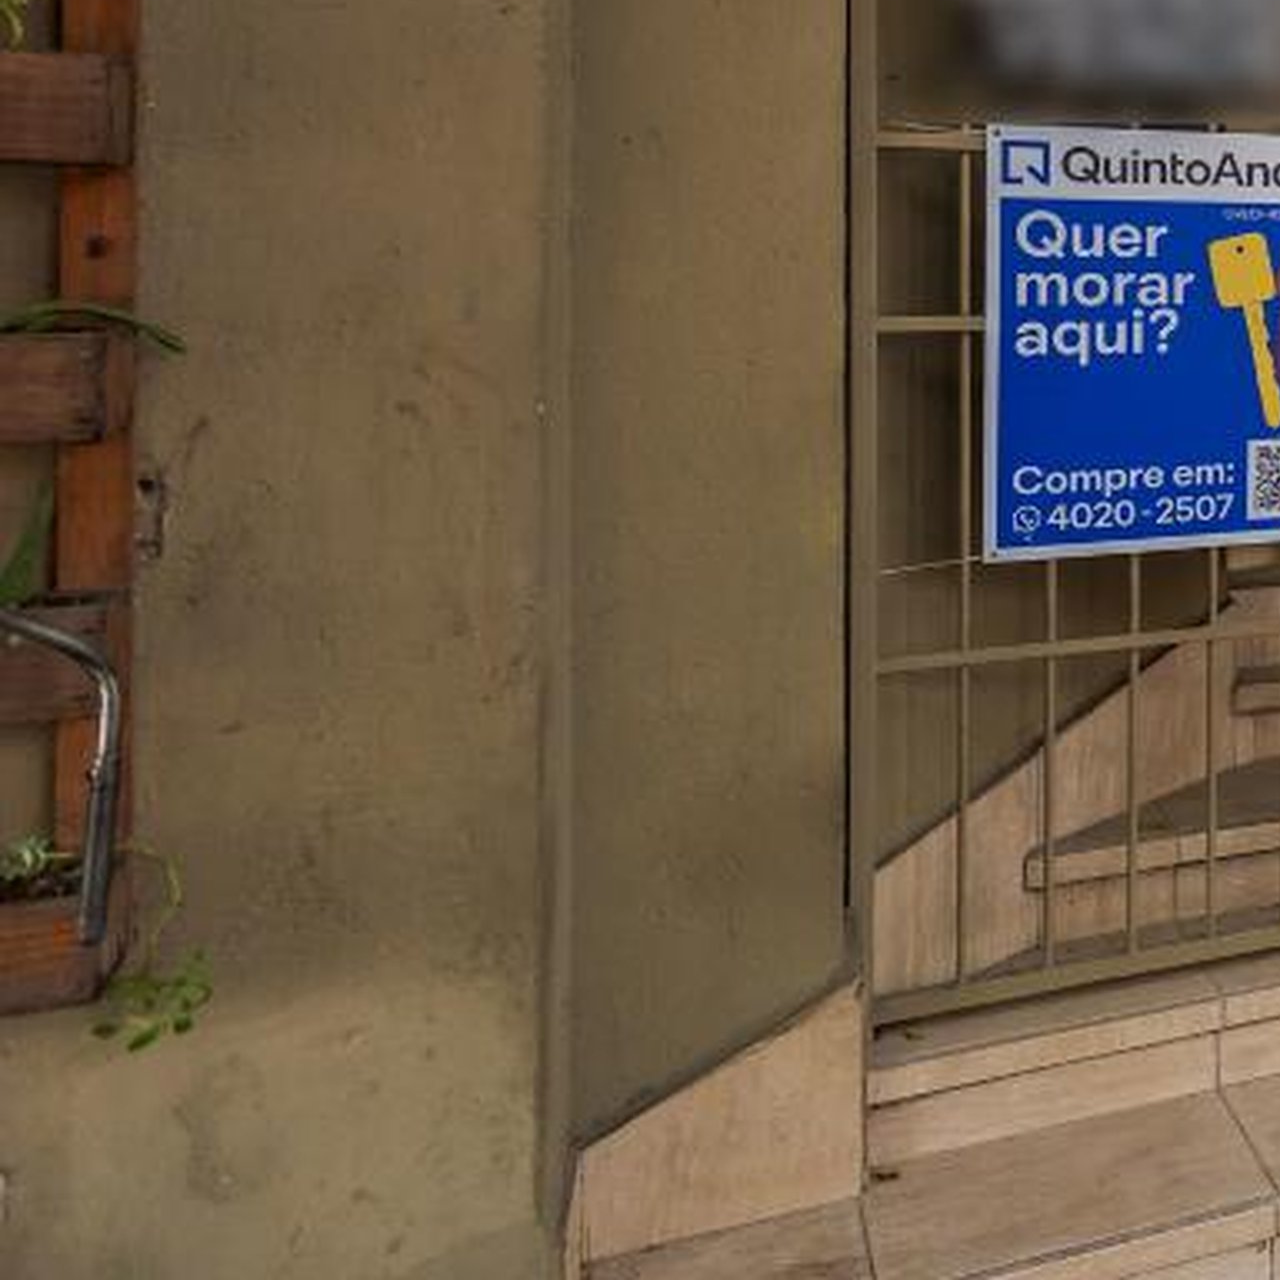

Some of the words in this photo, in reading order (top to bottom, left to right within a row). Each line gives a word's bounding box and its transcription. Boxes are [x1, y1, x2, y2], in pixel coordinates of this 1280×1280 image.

[1015, 210, 1168, 258] Quer
[1015, 268, 1195, 308] morar
[1014, 308, 1180, 367] aqui?
[1012, 464, 1165, 498] Compre
[1172, 460, 1236, 487] em:
